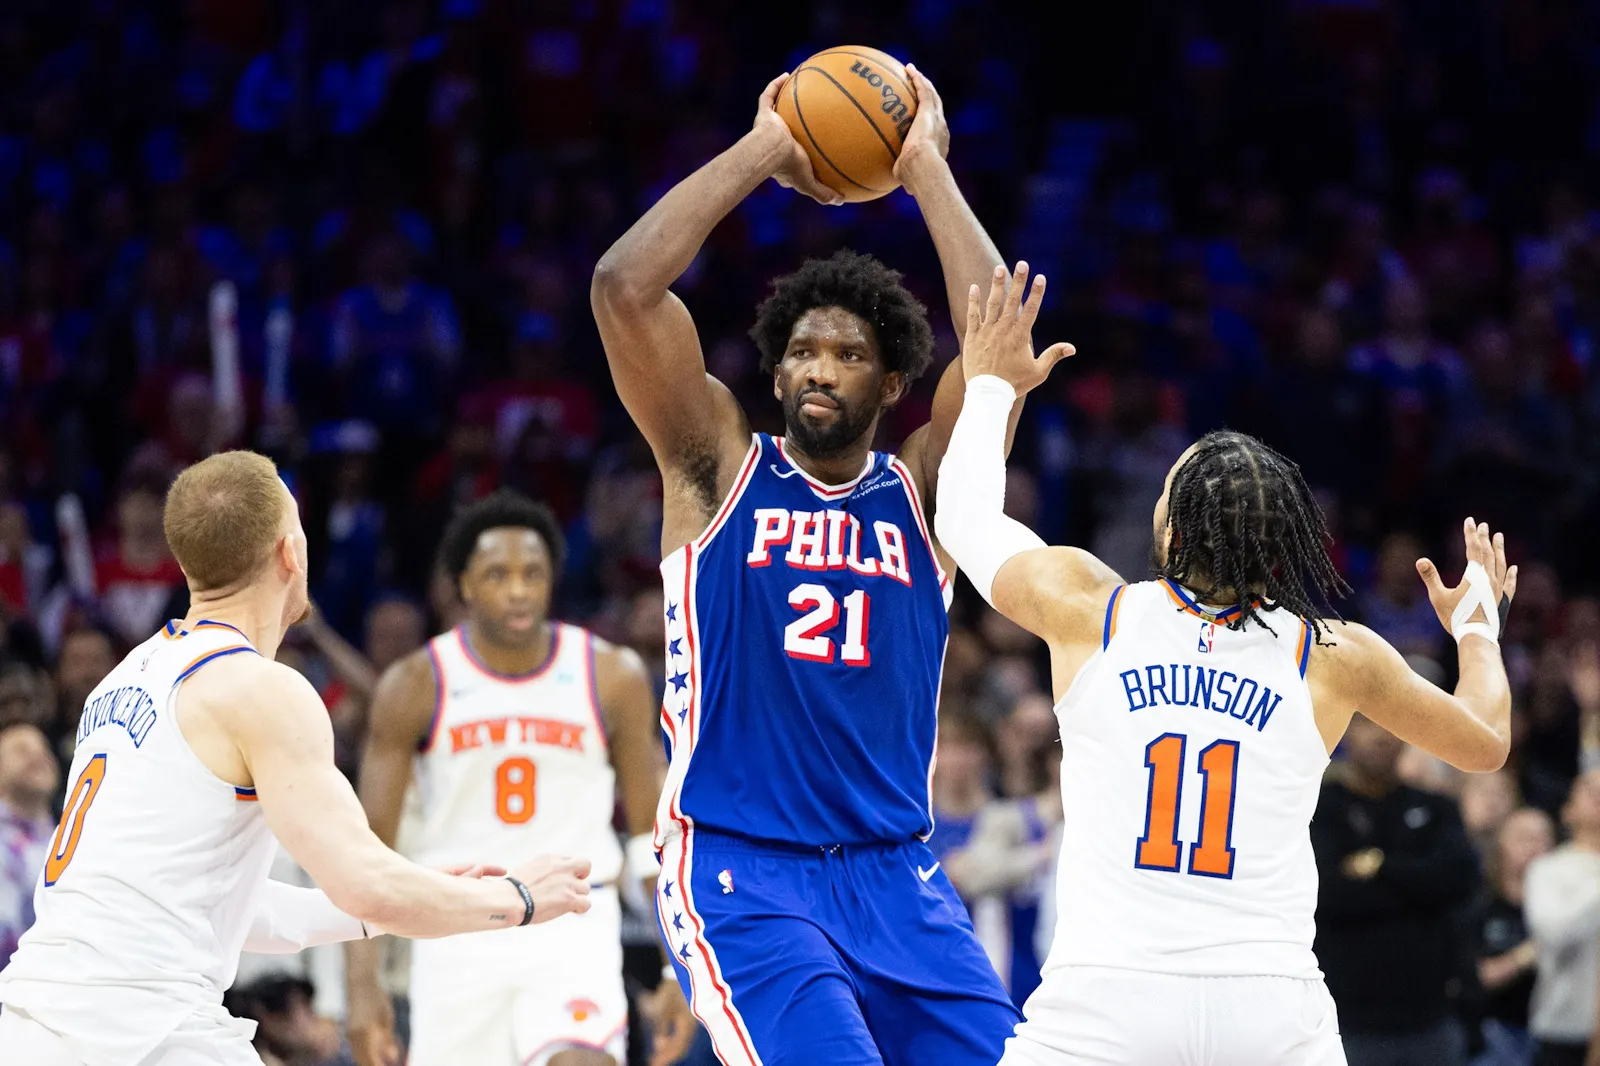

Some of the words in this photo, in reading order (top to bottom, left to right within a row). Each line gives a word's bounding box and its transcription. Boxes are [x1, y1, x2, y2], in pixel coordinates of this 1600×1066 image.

[851, 477, 901, 500] crypto.com
[747, 508, 913, 588] PHILA
[784, 582, 871, 667] 21
[1119, 663, 1283, 732] BRUNSON
[449, 717, 508, 755] NEW
[517, 716, 586, 755] YORK
[44, 752, 107, 888] 0
[496, 756, 537, 825] 8
[1134, 732, 1241, 880] 11
